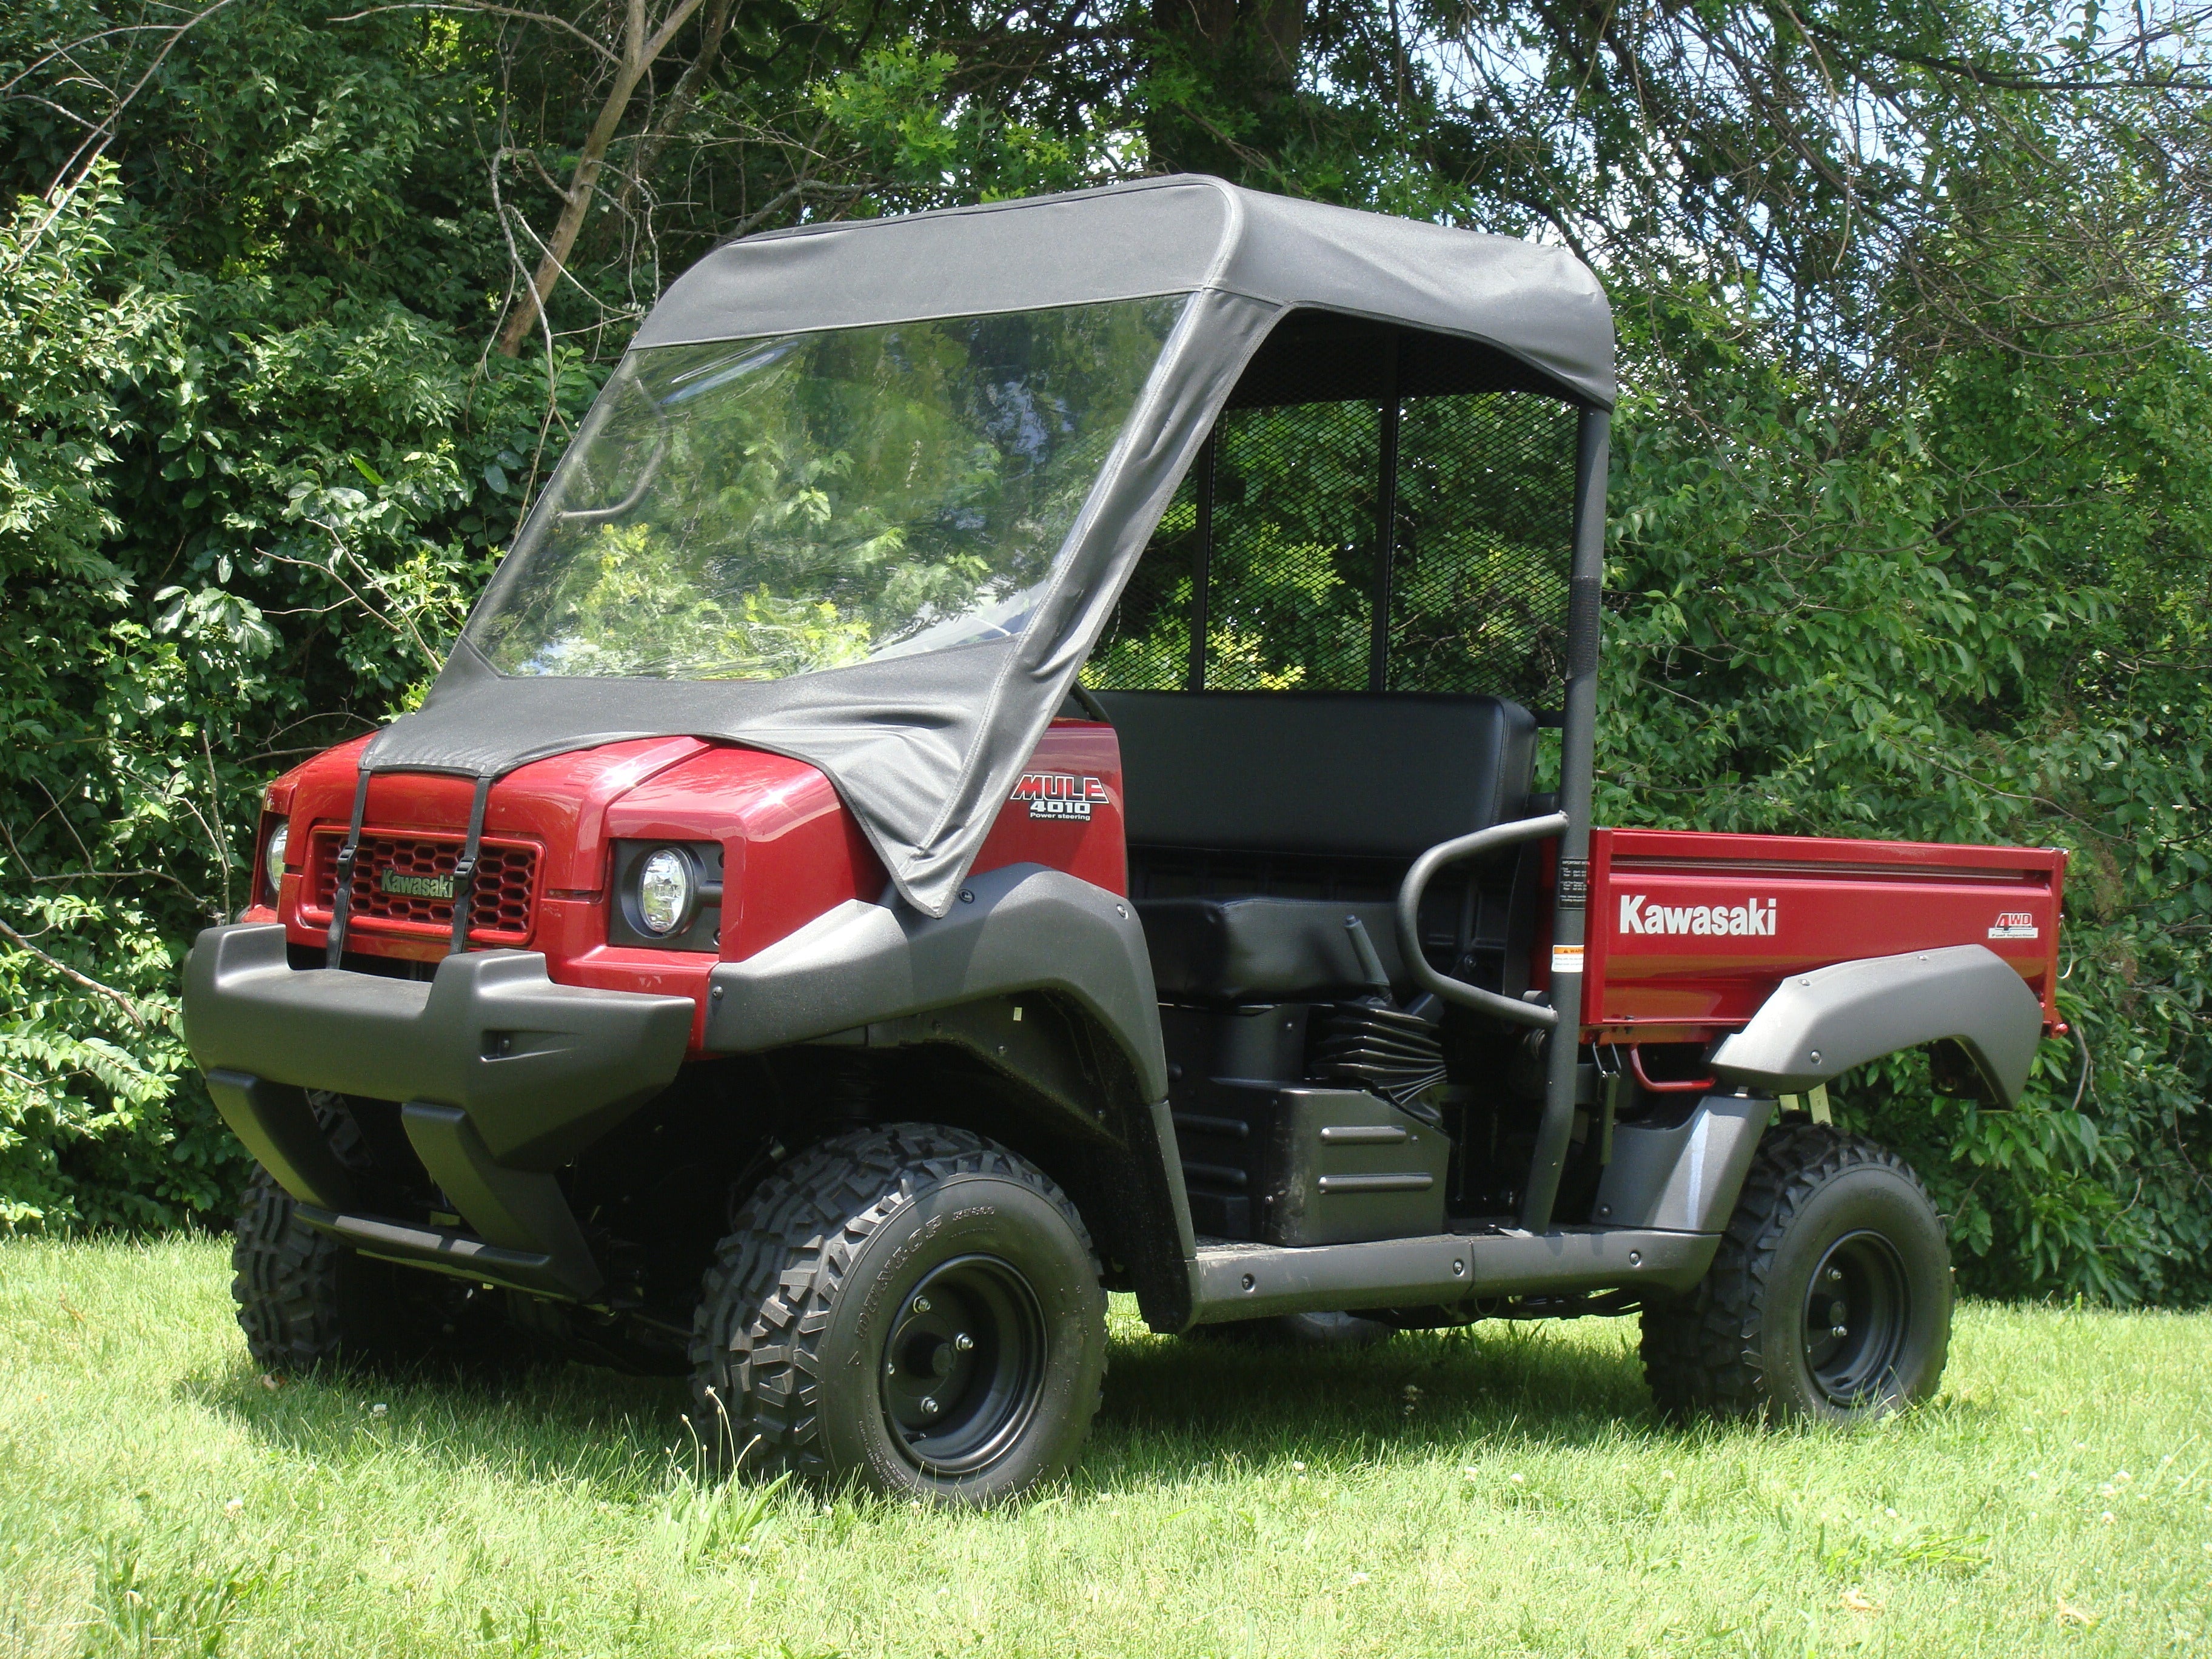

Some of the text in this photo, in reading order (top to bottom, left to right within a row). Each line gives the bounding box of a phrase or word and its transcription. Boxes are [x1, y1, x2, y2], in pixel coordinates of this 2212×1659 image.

[1010, 774, 1110, 804] MULE
[1030, 800, 1091, 814] 4010
[381, 870, 454, 898] Kawasaki
[1620, 894, 1777, 936] Kawasaki
[1994, 913, 2033, 932] 4WD
